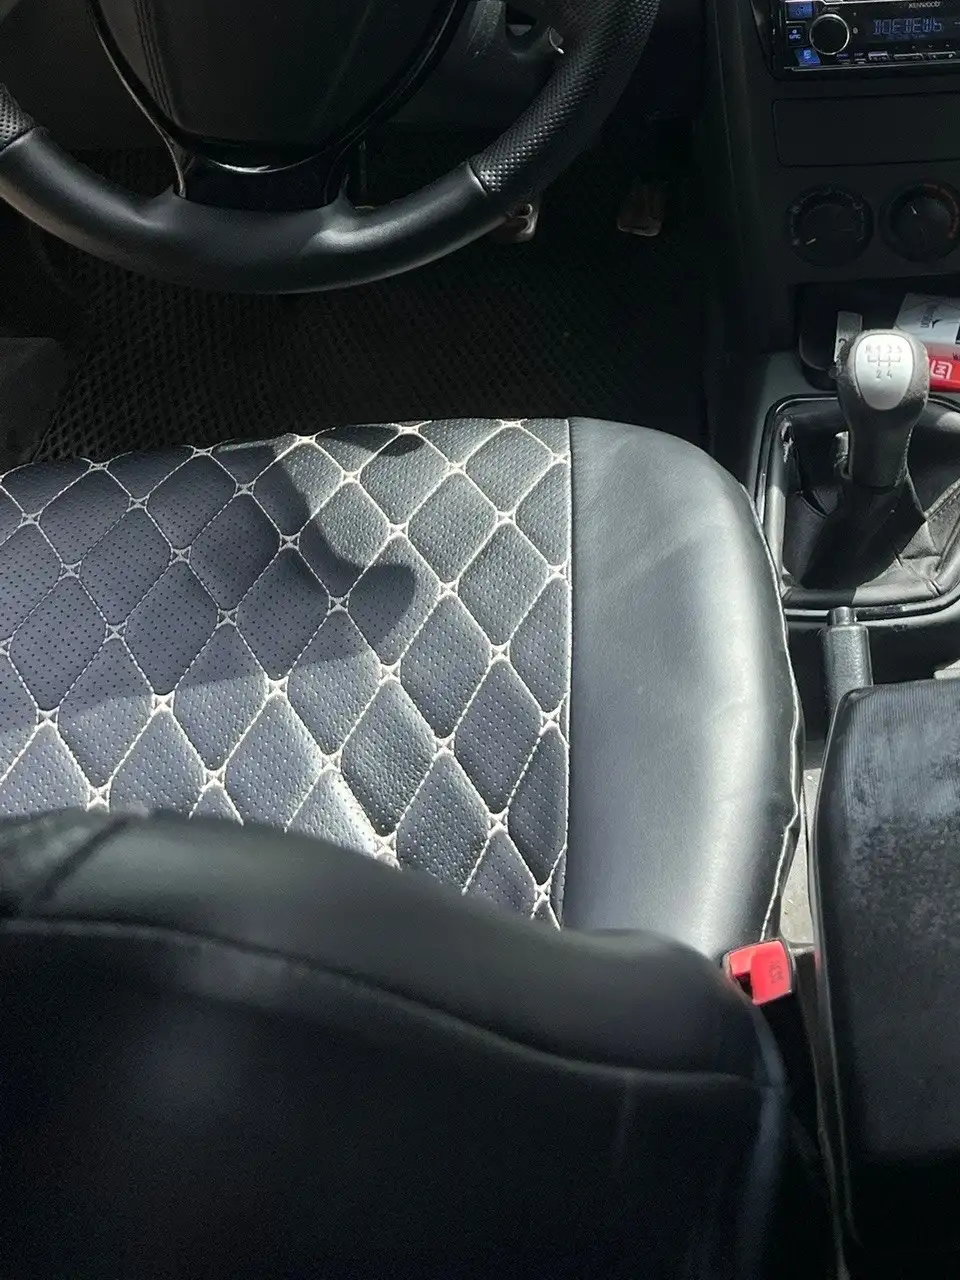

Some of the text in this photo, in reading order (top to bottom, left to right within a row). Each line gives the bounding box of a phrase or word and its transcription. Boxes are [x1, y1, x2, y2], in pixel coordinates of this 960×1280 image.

[907, 1, 941, 9] KENWOOD
[865, 344, 872, 354] R
[875, 370, 893, 380] 2 4
